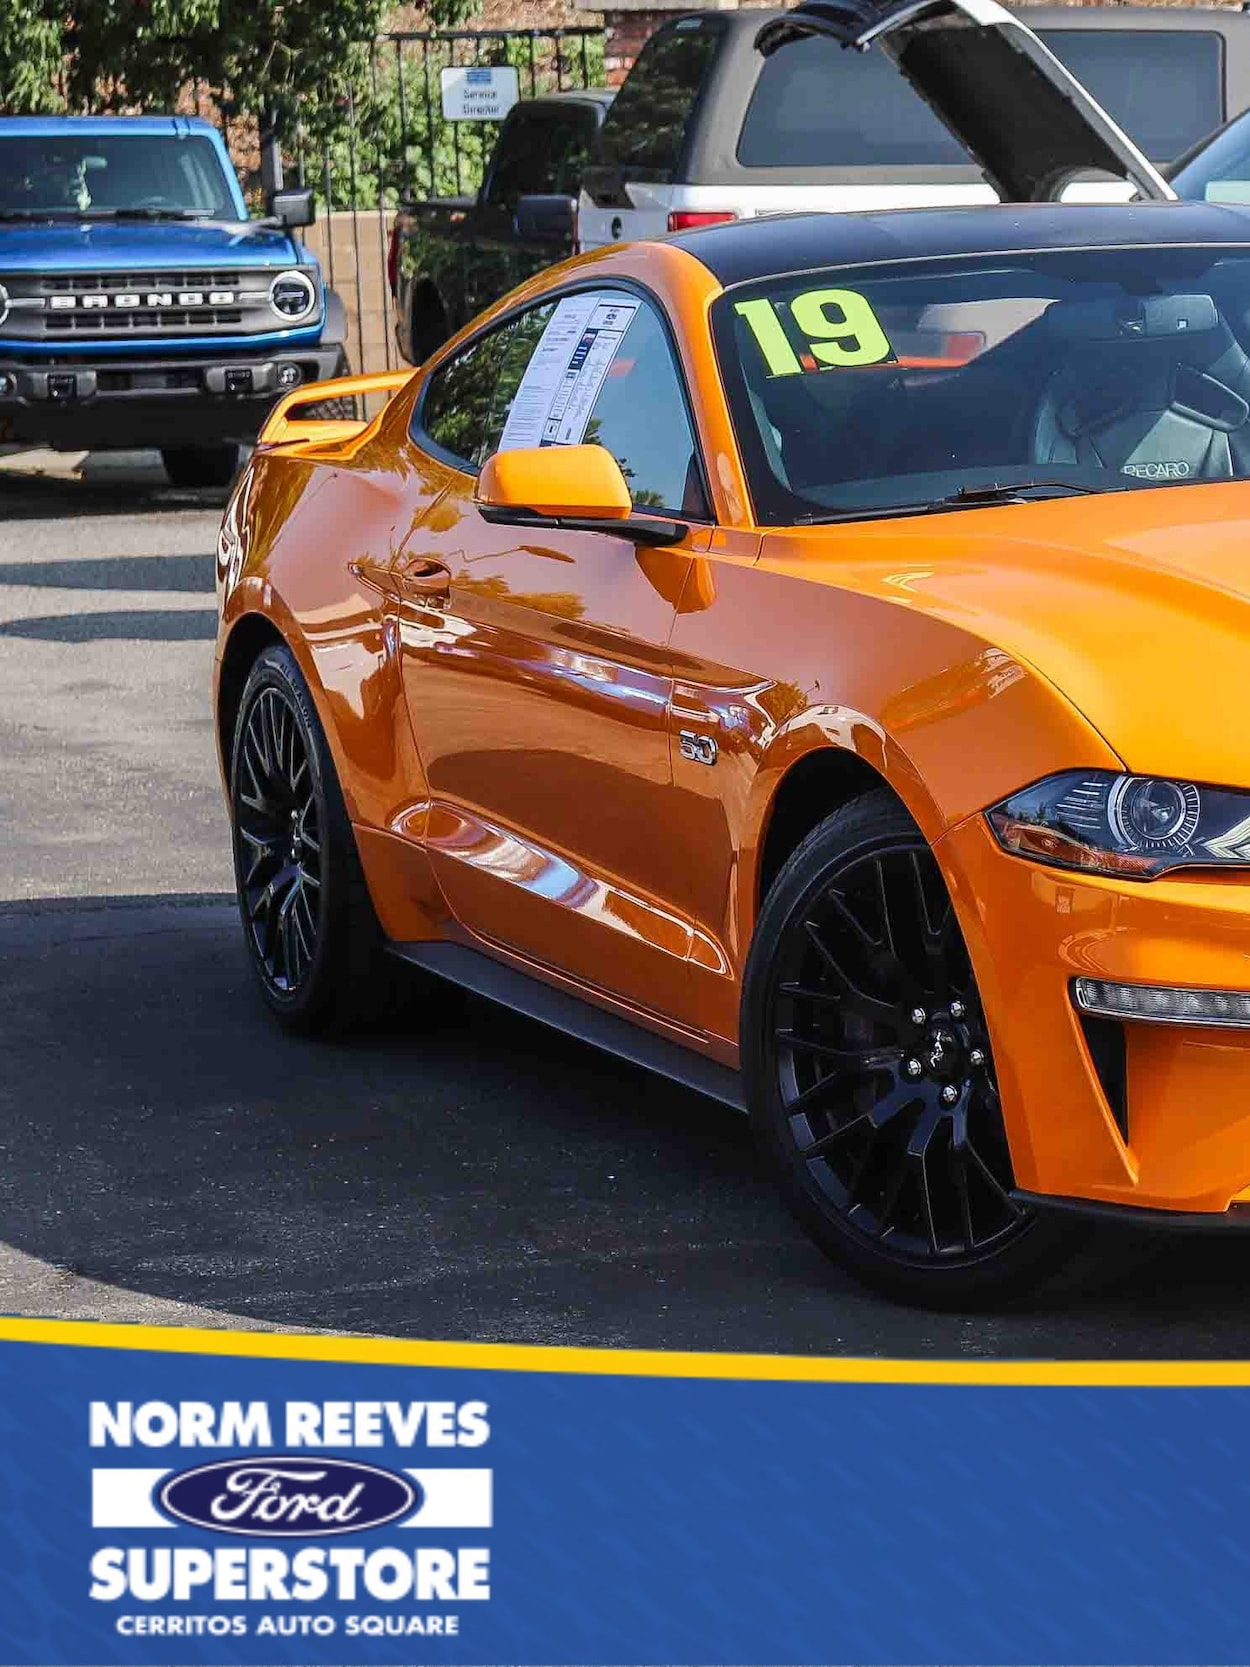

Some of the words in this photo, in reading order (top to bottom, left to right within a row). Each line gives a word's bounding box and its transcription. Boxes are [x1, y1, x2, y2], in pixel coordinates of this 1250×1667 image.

[50, 292, 235, 309] BRONCO
[734, 288, 891, 376] 19
[1123, 461, 1190, 478] RECARO
